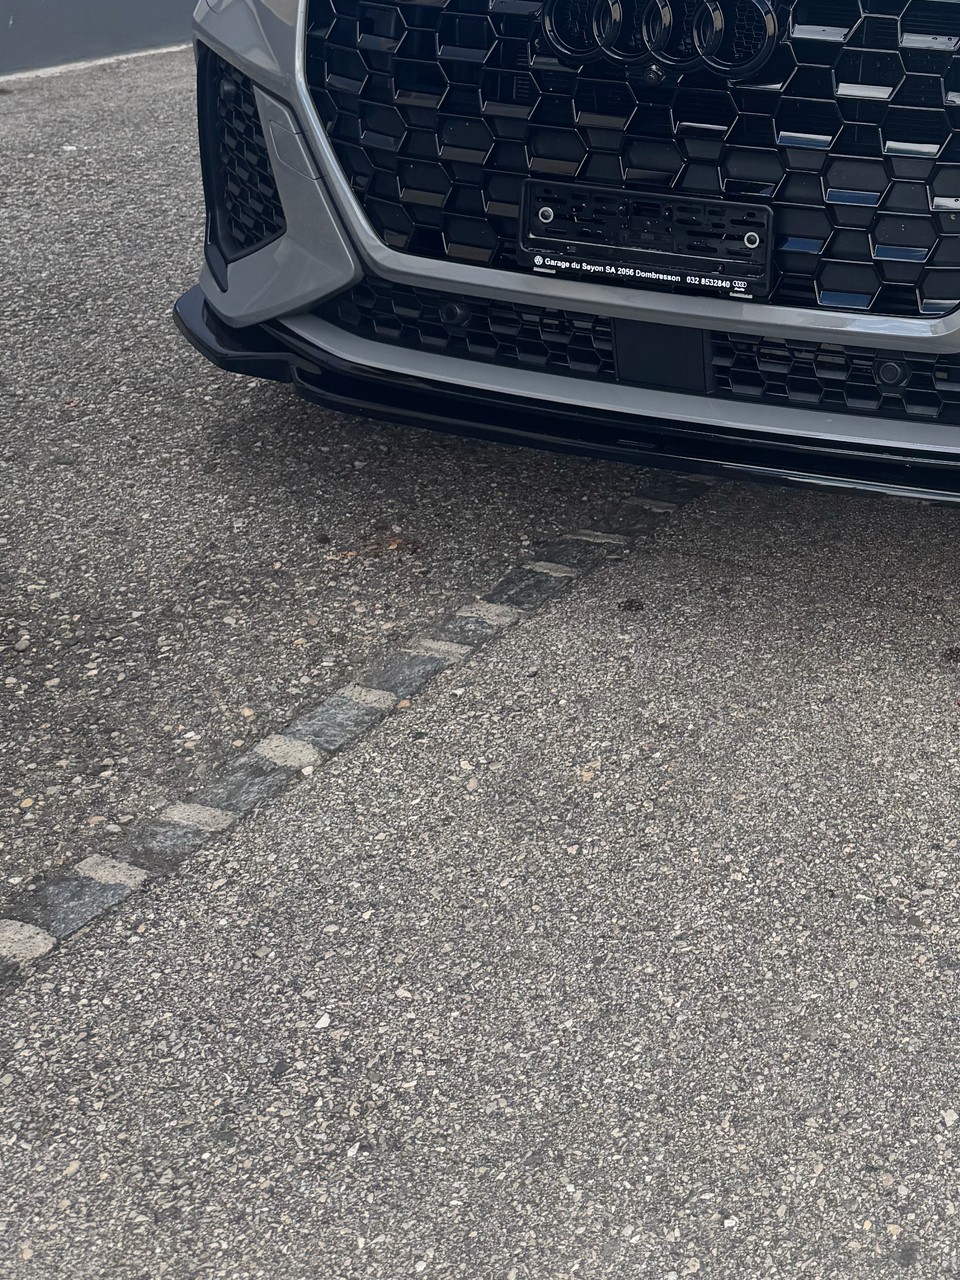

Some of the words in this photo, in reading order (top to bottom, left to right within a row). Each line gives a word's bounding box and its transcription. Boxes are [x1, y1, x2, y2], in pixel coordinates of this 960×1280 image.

[544, 257, 570, 269] Garage
[571, 261, 581, 269] du
[582, 262, 604, 273] Seyon
[605, 265, 616, 274] SA
[617, 267, 634, 276] 2056
[635, 269, 681, 282] Dombresson
[686, 276, 700, 285] 032
[700, 278, 731, 288] 8532840
